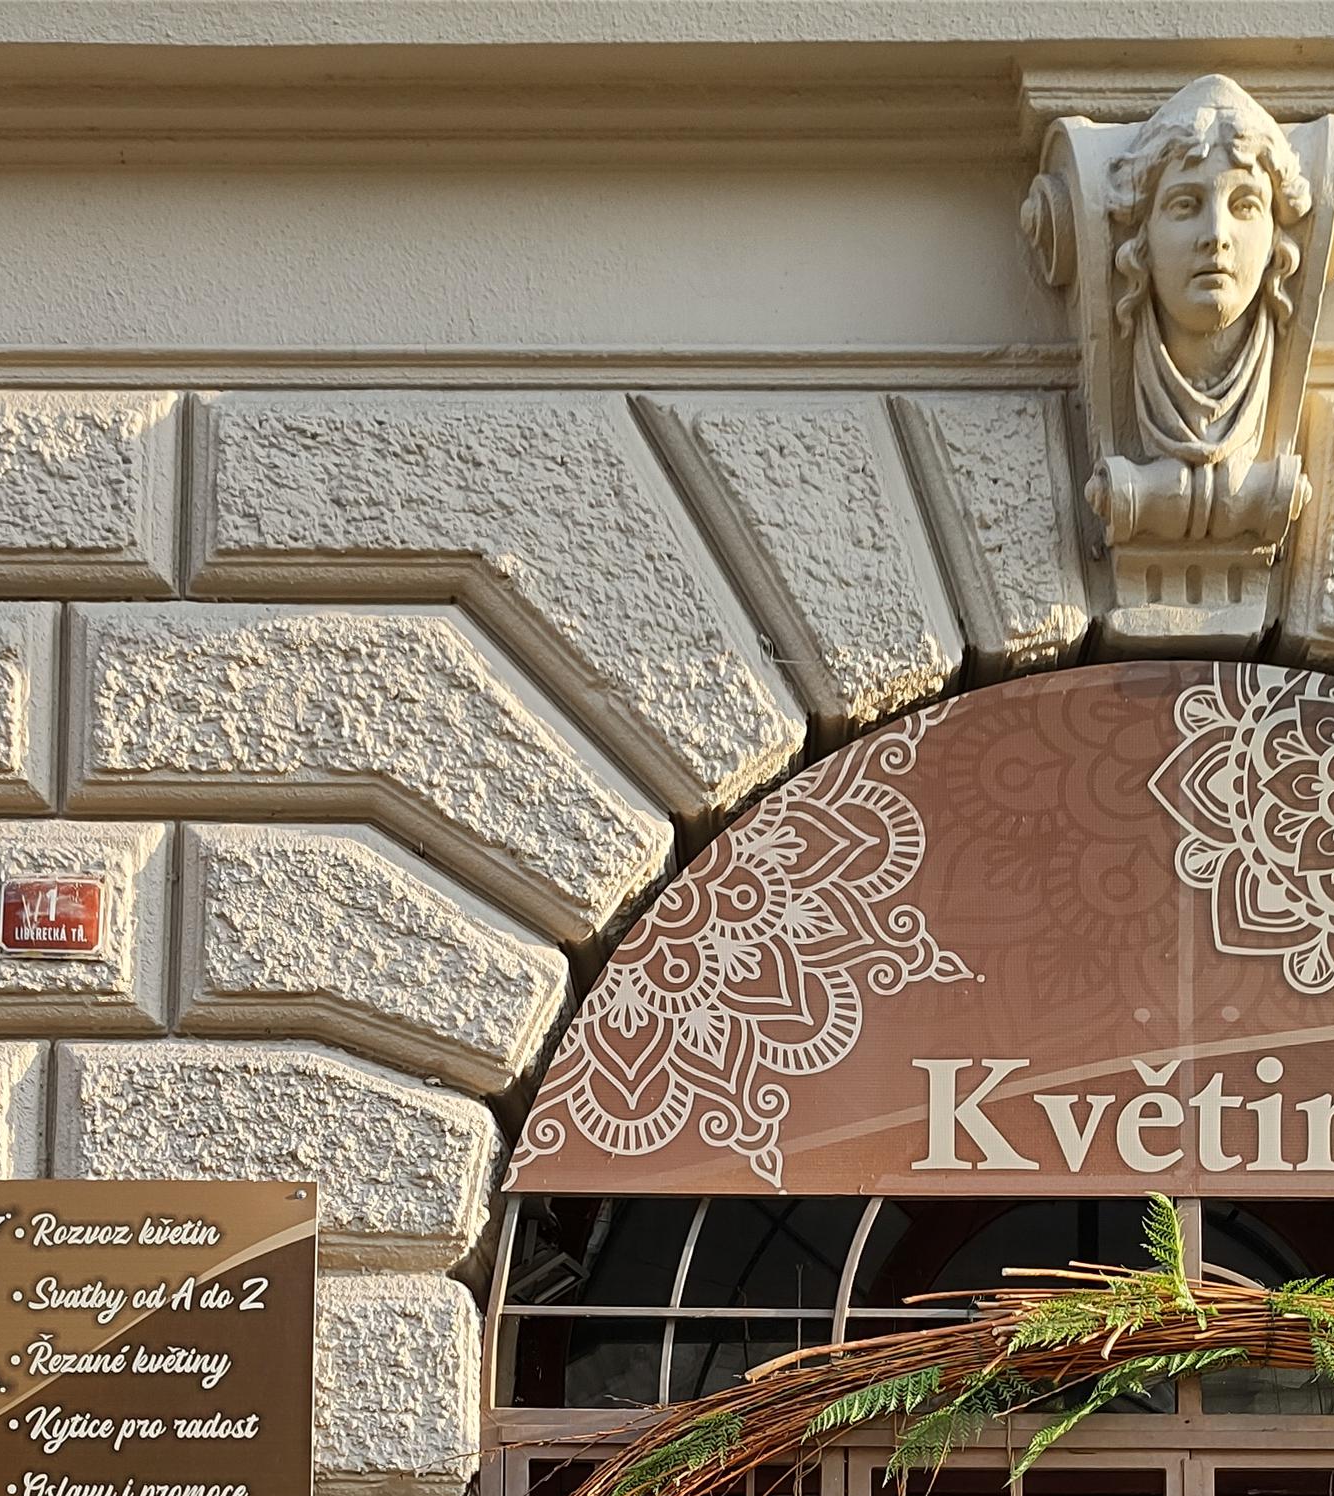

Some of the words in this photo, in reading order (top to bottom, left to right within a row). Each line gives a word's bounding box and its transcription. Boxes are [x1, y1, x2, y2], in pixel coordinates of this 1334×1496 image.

[30, 1212, 134, 1247] Rozvoz
[138, 1217, 221, 1246] květin
[27, 1276, 128, 1325] Svatby
[131, 1282, 168, 1310] od
[170, 1276, 196, 1311] A
[199, 1282, 234, 1310] do
[26, 1333, 131, 1375] Řezané
[131, 1345, 232, 1390] květiny
[25, 1405, 115, 1454] Kytice
[114, 1418, 166, 1451] pro
[172, 1412, 260, 1440] radost
